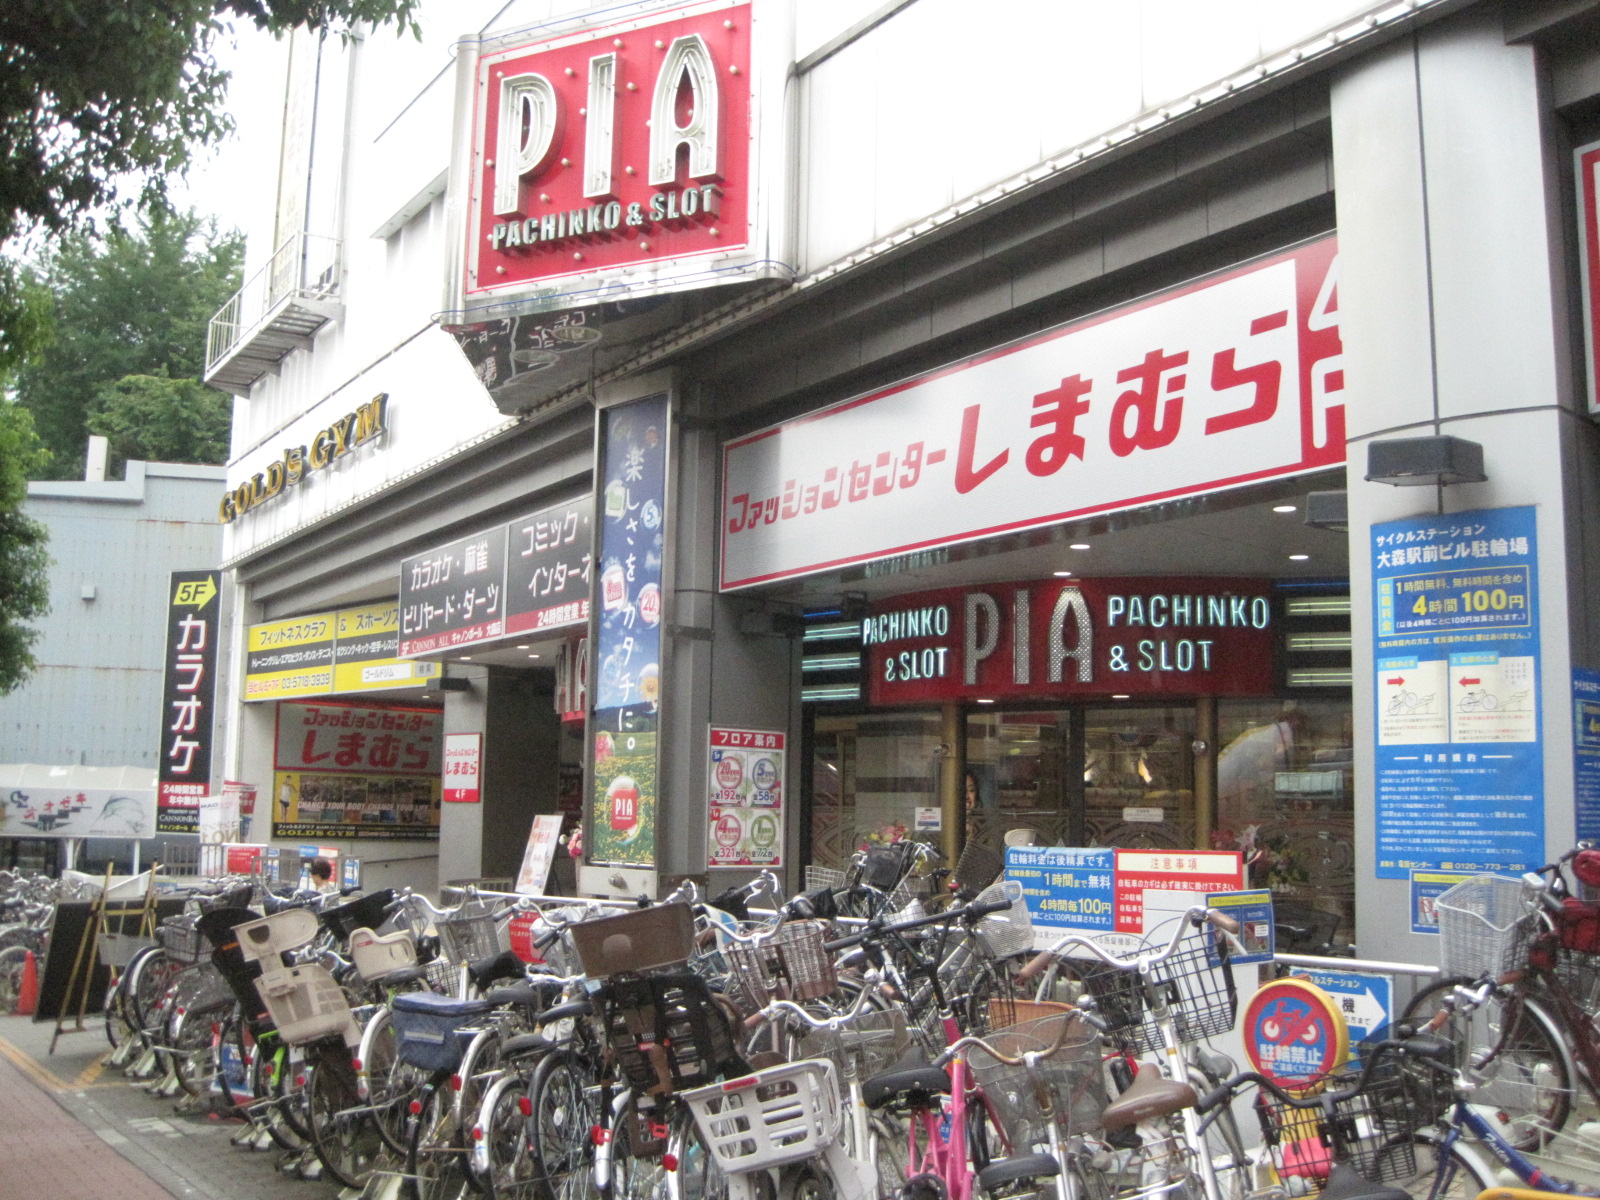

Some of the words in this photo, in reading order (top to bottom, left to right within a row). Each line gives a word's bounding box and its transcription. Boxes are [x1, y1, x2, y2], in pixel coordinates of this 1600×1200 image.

[494, 33, 725, 217] PIA
[491, 201, 620, 250] PACHINKO
[626, 201, 644, 226] &
[650, 184, 724, 221] SLOT
[728, 441, 947, 534] ファッションセンター
[954, 310, 1289, 495] しまむら
[219, 445, 308, 524] GOLD'S
[310, 392, 389, 470] GYM
[1376, 524, 1486, 547] サイクルステーション
[1377, 536, 1529, 569] 大森駅前ビル駐輪場
[180, 583, 207, 602] 5F
[537, 602, 579, 627] 24時間営業
[862, 605, 949, 646] PACHINKO
[1107, 594, 1270, 630] PACHINKO
[260, 620, 327, 645] フィットネスクラブ
[963, 585, 1094, 686] PIA
[885, 658, 896, 682] &
[899, 646, 949, 680] SLOT
[1109, 645, 1129, 672] &
[1138, 639, 1213, 672] SLOT
[170, 614, 207, 774] カラオケ
[303, 708, 433, 732] ファッションセンター
[301, 729, 433, 770] しまむら
[719, 732, 777, 748] フロア案内
[446, 761, 478, 775] しまむら
[615, 798, 634, 816] PIA
[1009, 853, 1109, 868] 駐輪料金は後精算です。
[1151, 857, 1198, 870] 注意事項
[1040, 898, 1112, 915] 4時間毎100円
[1260, 1043, 1322, 1066] 駐輪禁止
